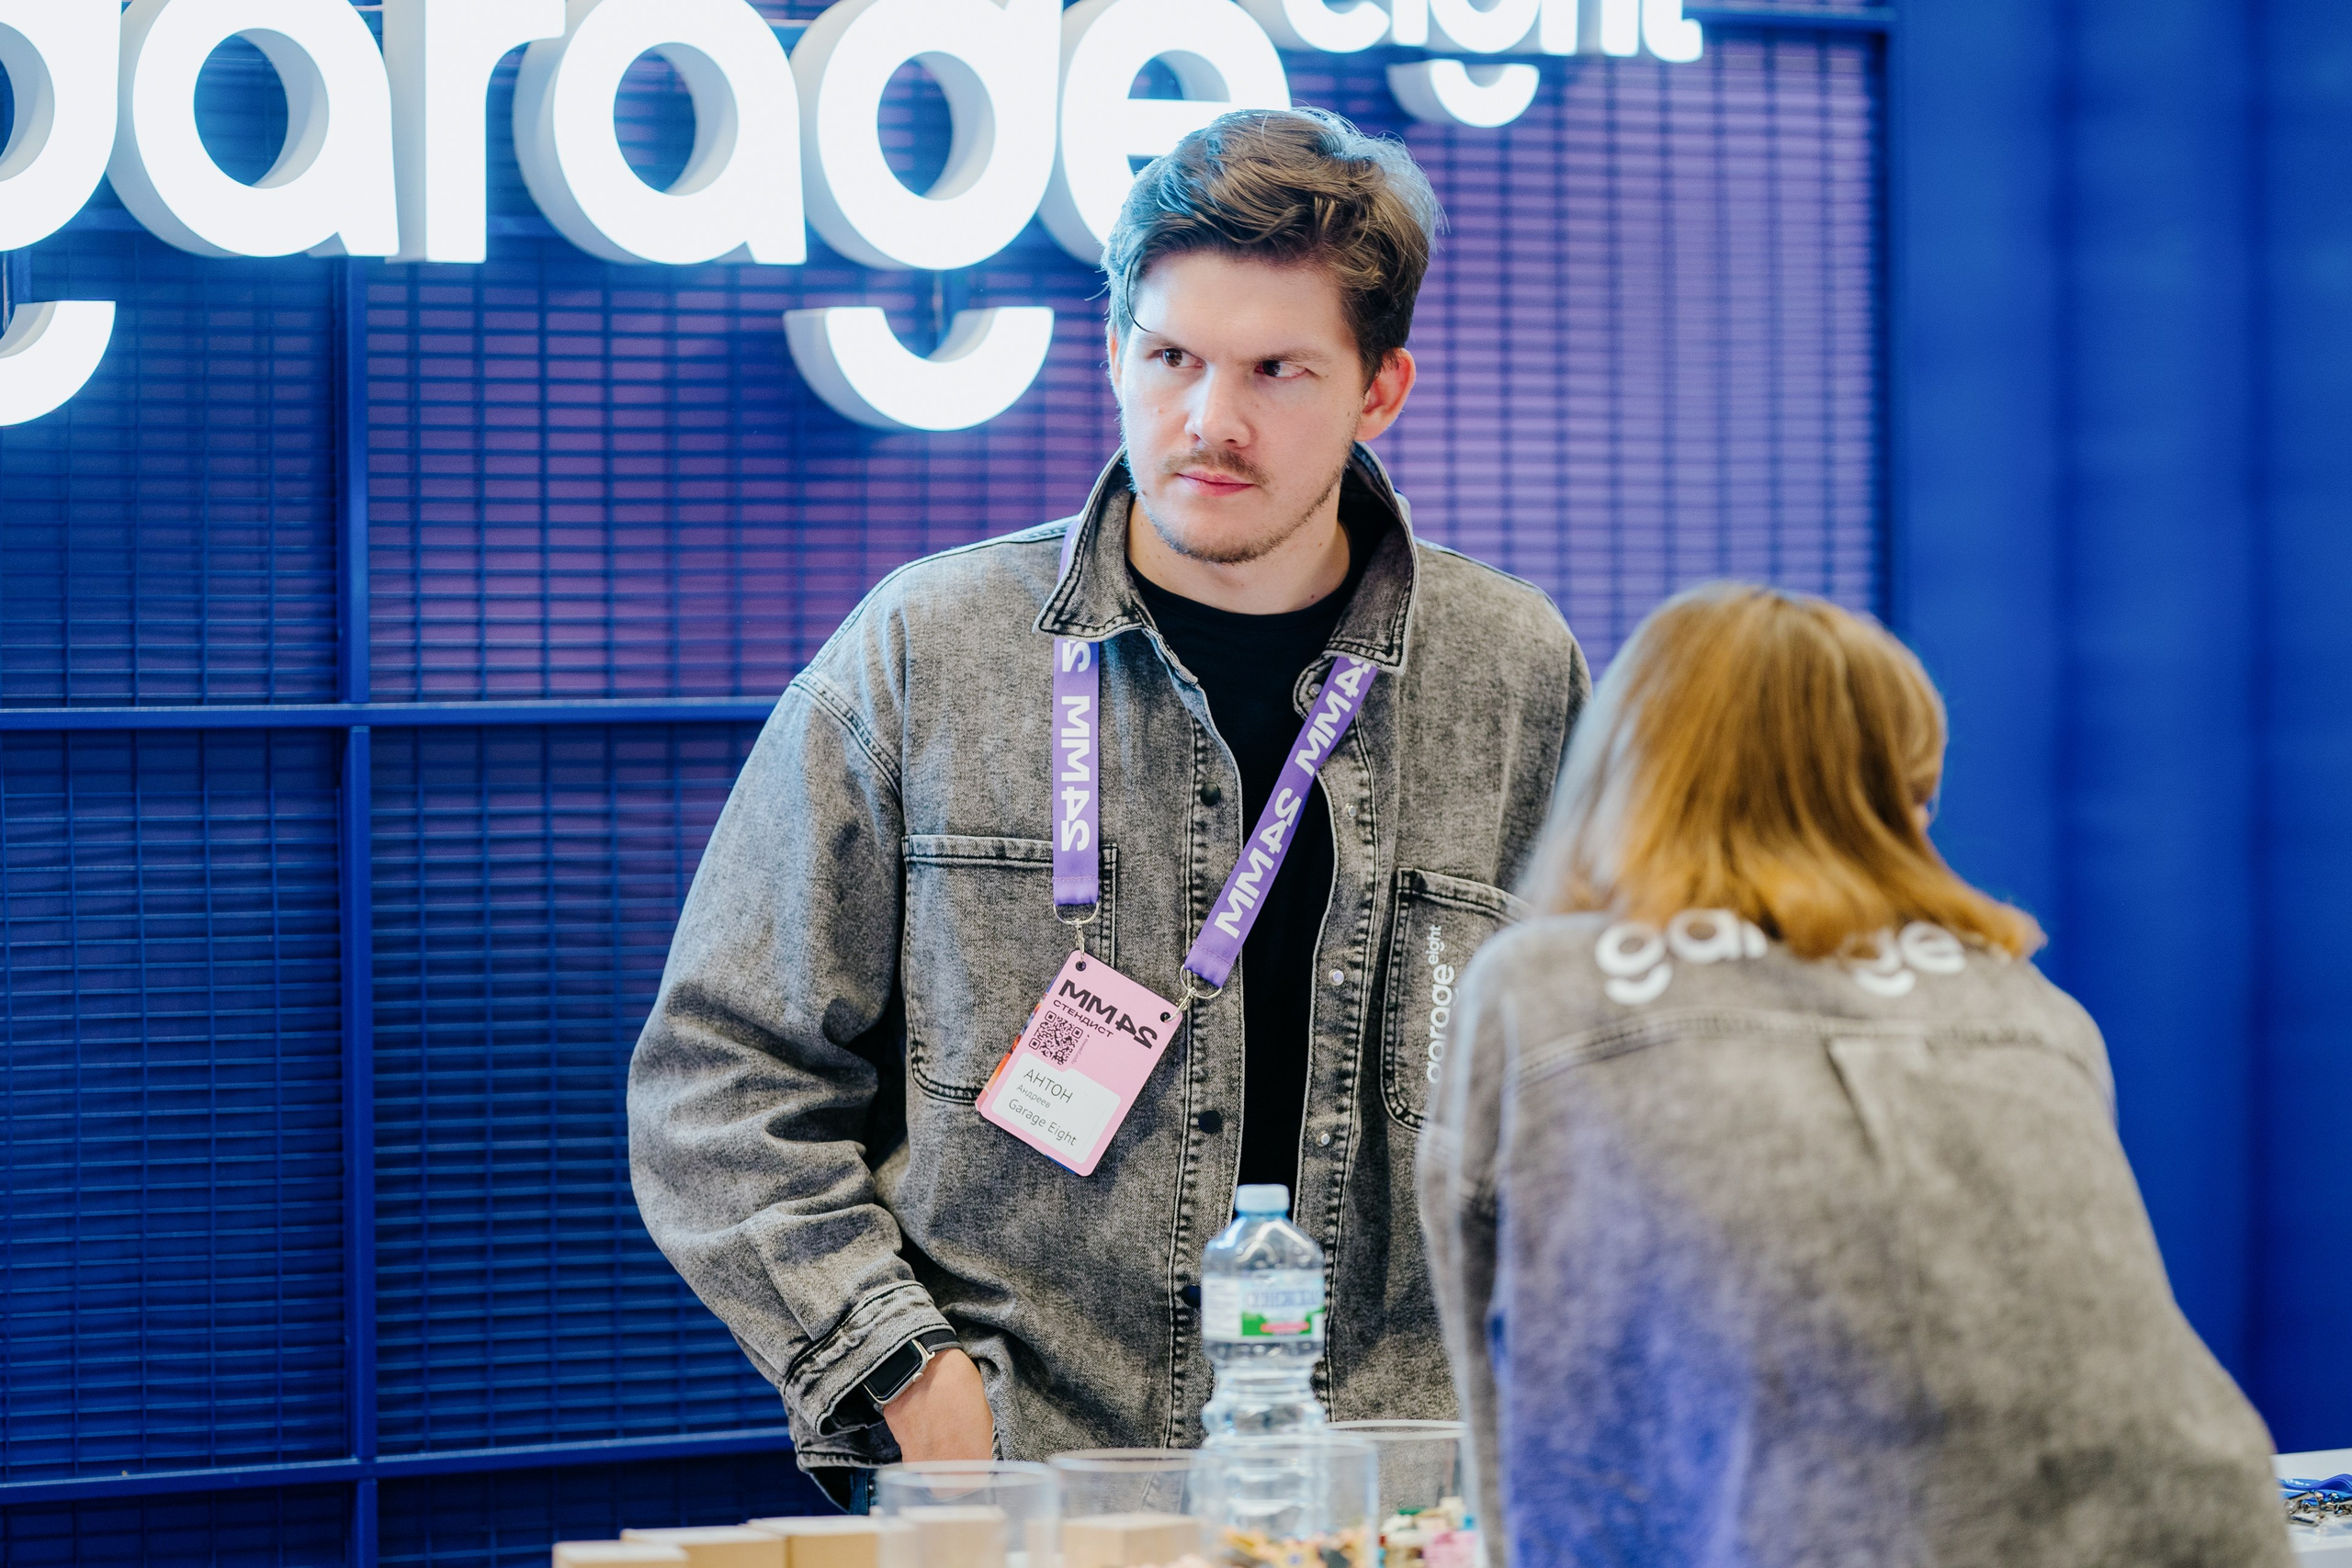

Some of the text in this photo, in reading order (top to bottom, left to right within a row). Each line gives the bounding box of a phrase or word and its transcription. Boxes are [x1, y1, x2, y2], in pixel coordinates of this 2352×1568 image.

[1425, 924, 1445, 965] eight
[1053, 999, 1114, 1037] СТЕНДИСТ
[1017, 1084, 1051, 1109] Андреев
[1023, 1069, 1073, 1103] АНТОН
[1009, 1099, 1077, 1145] Garage Eight
